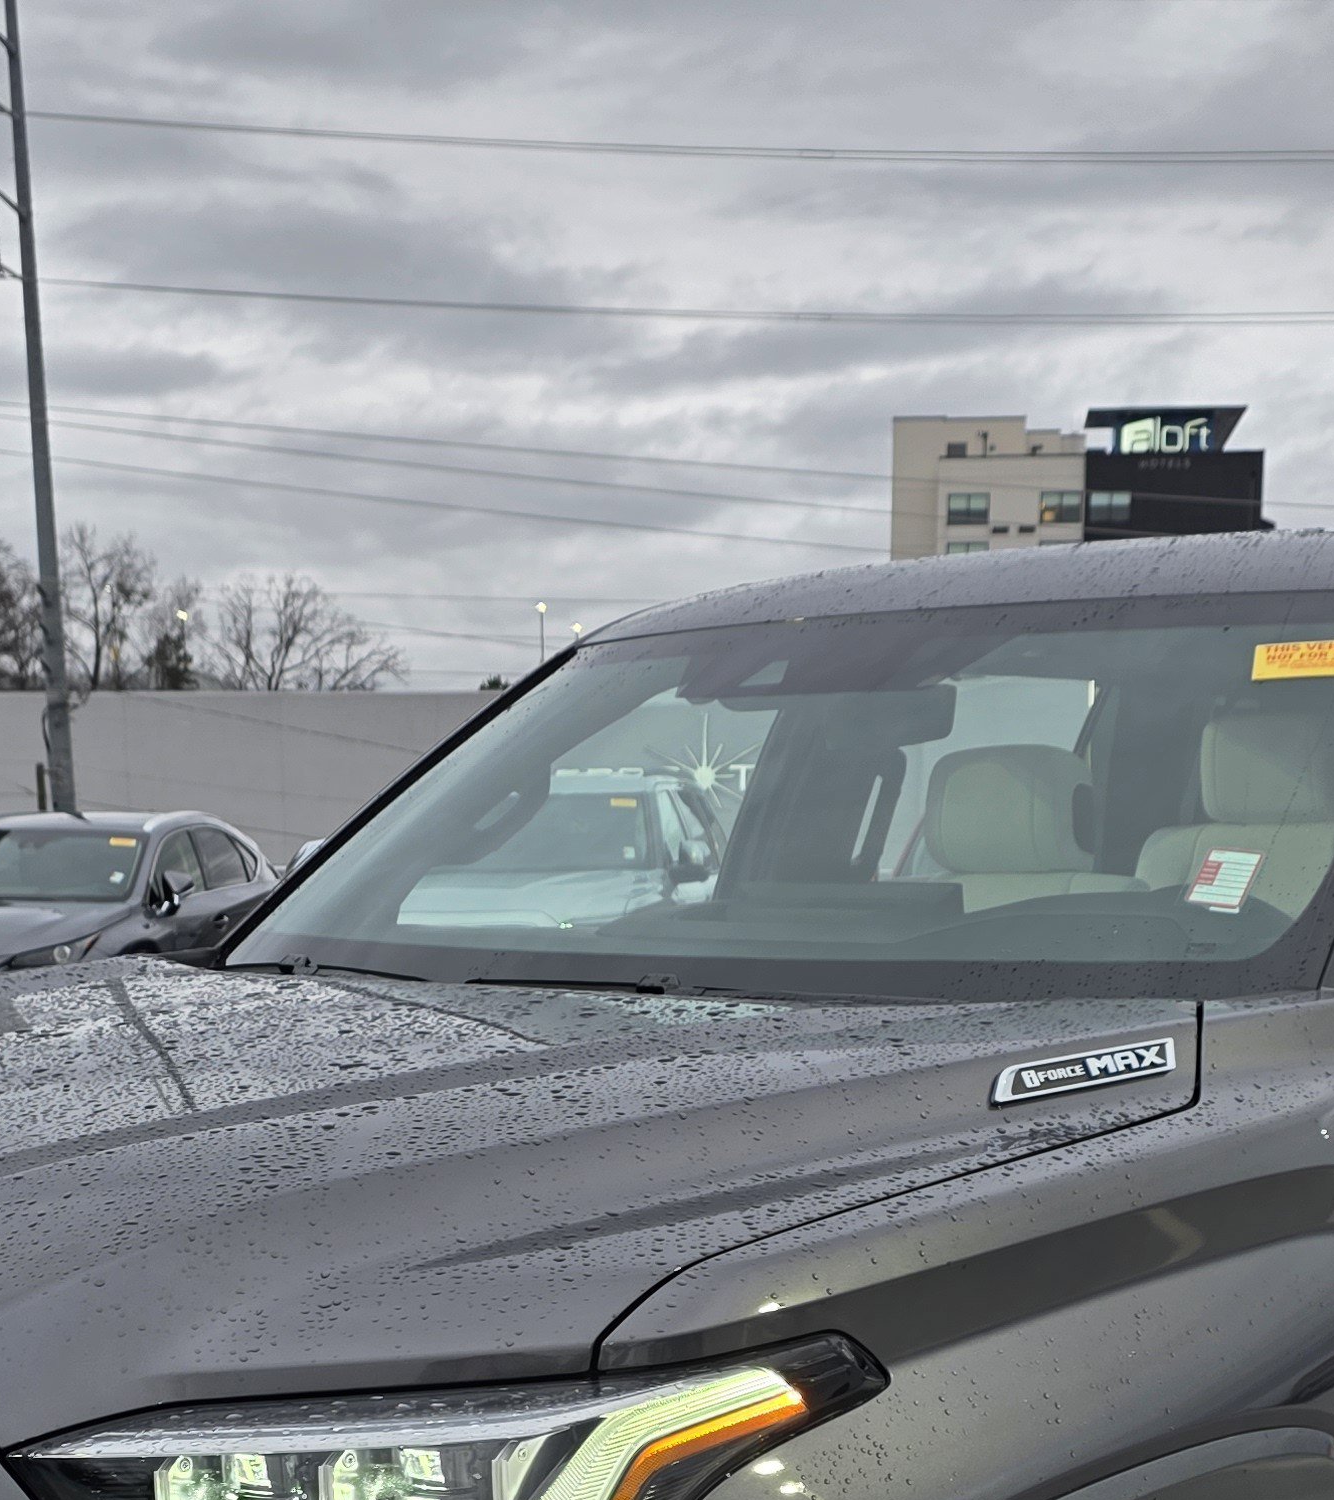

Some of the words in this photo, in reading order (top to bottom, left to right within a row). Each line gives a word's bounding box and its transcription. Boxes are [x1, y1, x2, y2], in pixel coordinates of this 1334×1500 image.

[1120, 416, 1211, 455] aloft
[1265, 643, 1302, 655] THIS
[1266, 651, 1294, 662] NOT
[1299, 649, 1329, 661] FOR
[1086, 1045, 1166, 1077] MAX
